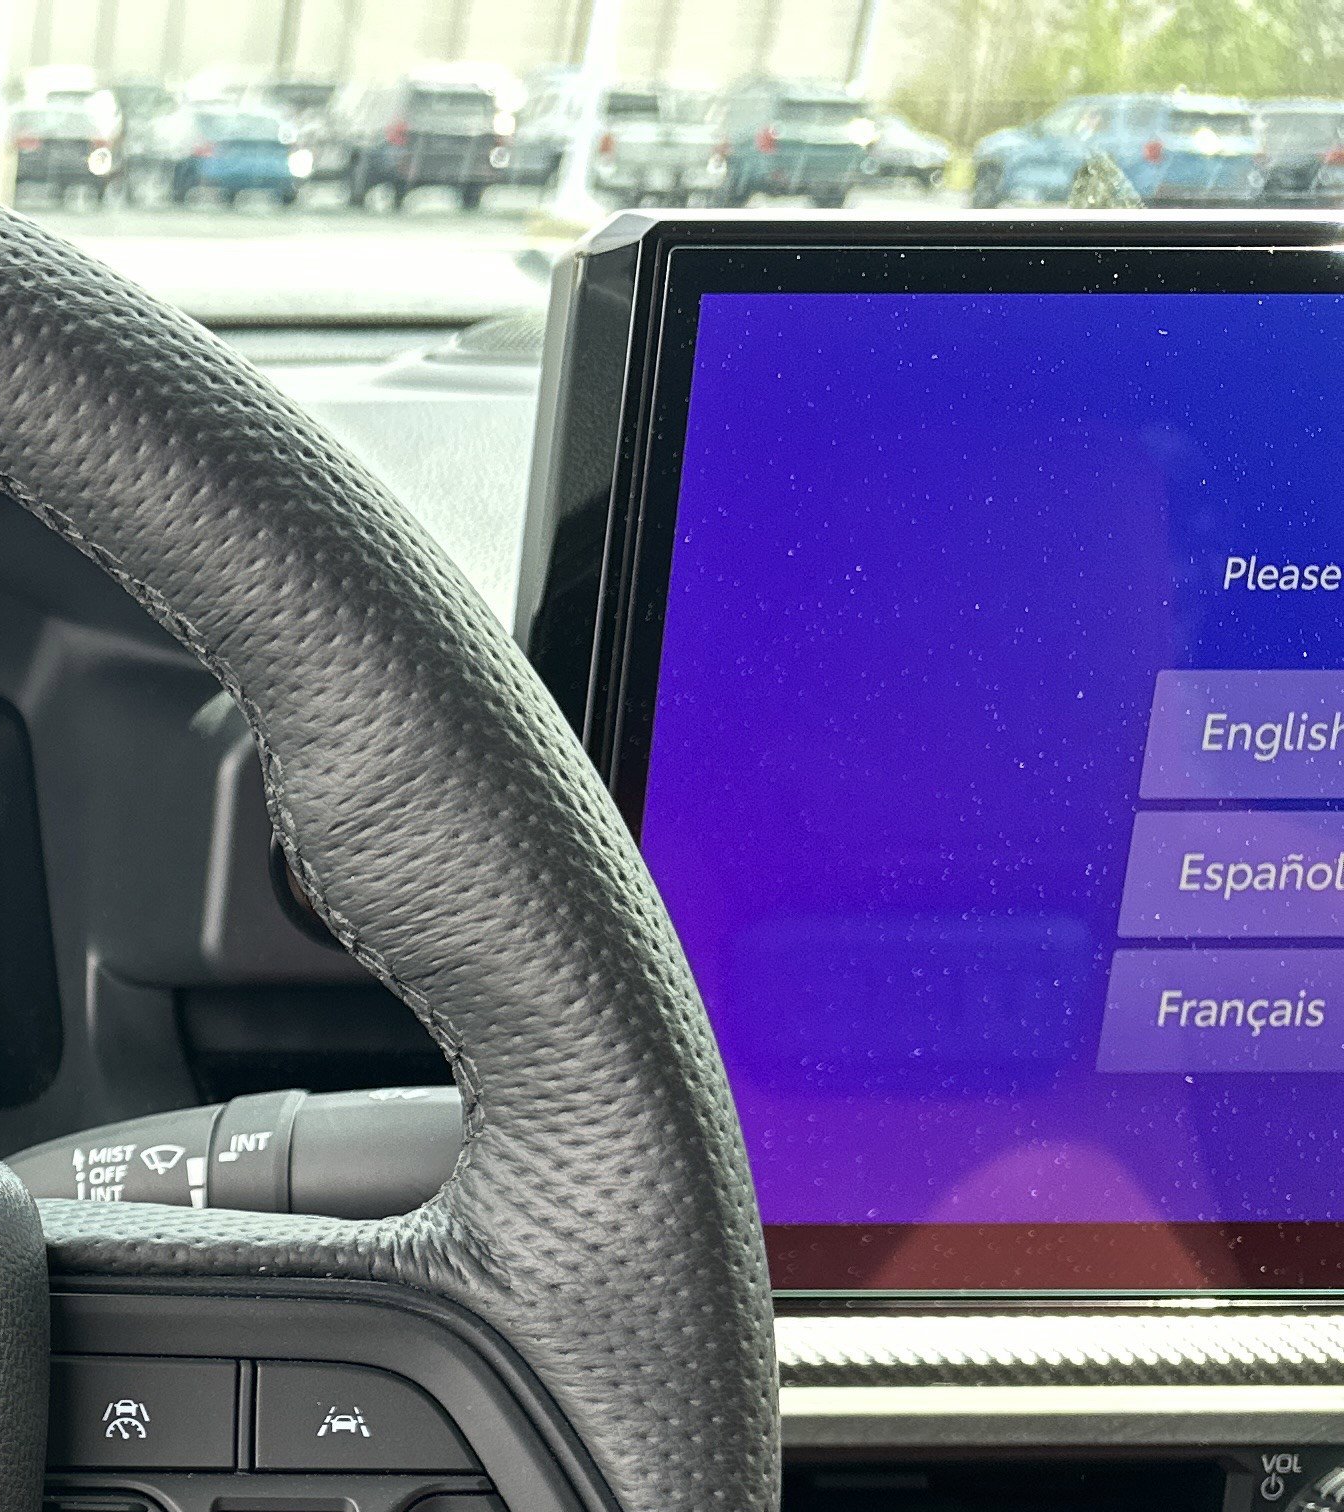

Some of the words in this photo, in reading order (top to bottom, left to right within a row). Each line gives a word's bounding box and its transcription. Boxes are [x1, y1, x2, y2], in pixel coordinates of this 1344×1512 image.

[1222, 557, 1343, 591] Please
[1177, 853, 1344, 900] Español
[1156, 989, 1326, 1036] Français
[229, 1131, 273, 1154] INT
[87, 1144, 138, 1165] MIST
[88, 1166, 129, 1185] OFF
[89, 1184, 126, 1202] INT
[1260, 1453, 1302, 1474] VOL
